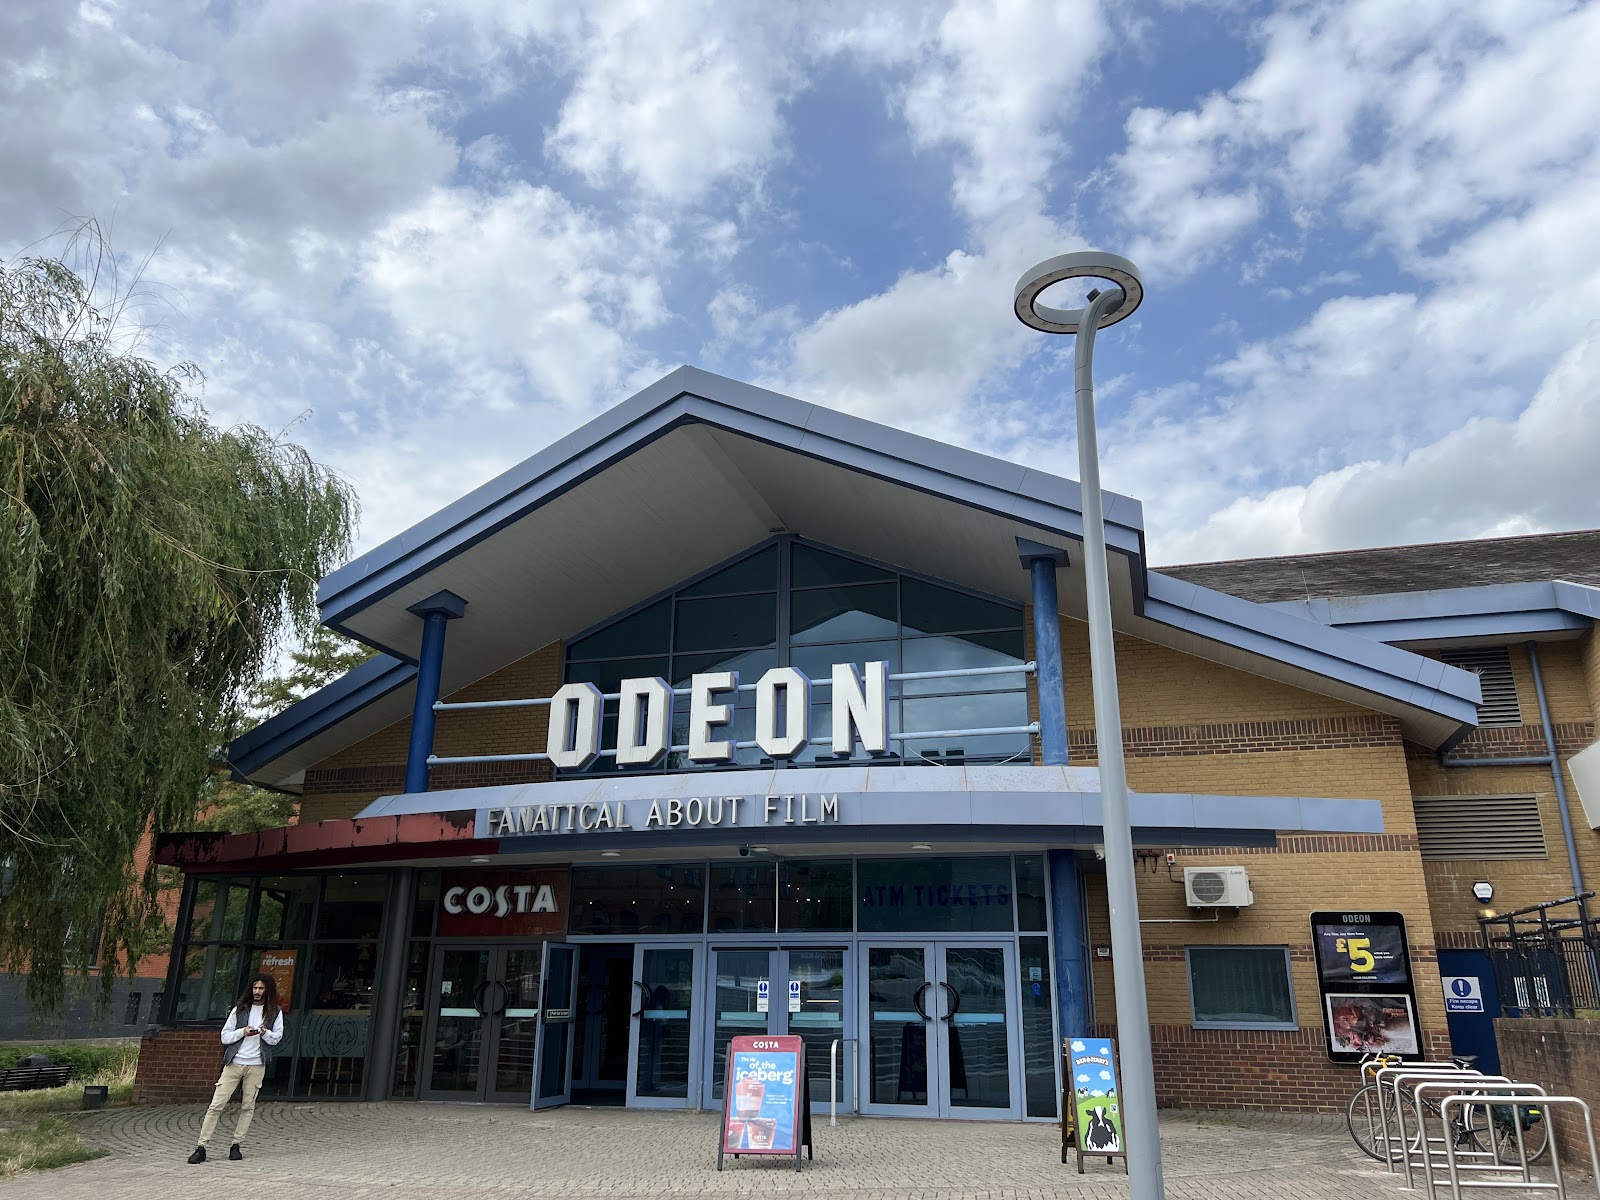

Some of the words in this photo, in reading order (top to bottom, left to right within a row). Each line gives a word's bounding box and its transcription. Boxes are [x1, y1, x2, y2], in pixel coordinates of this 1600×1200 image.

[547, 660, 889, 772] ODEON
[487, 801, 632, 836] FANATICAL
[646, 797, 744, 828] ABOUT
[764, 793, 838, 823] FILM
[443, 884, 558, 918] COSTA
[864, 885, 905, 907] ATM
[914, 884, 1009, 906] TICKETS
[1342, 914, 1371, 923] ODEON
[262, 956, 294, 966] refresh
[753, 1041, 779, 1049] COSTA
[749, 1061, 759, 1069] of
[761, 1061, 776, 1069] the
[736, 1067, 794, 1085] iceberg
